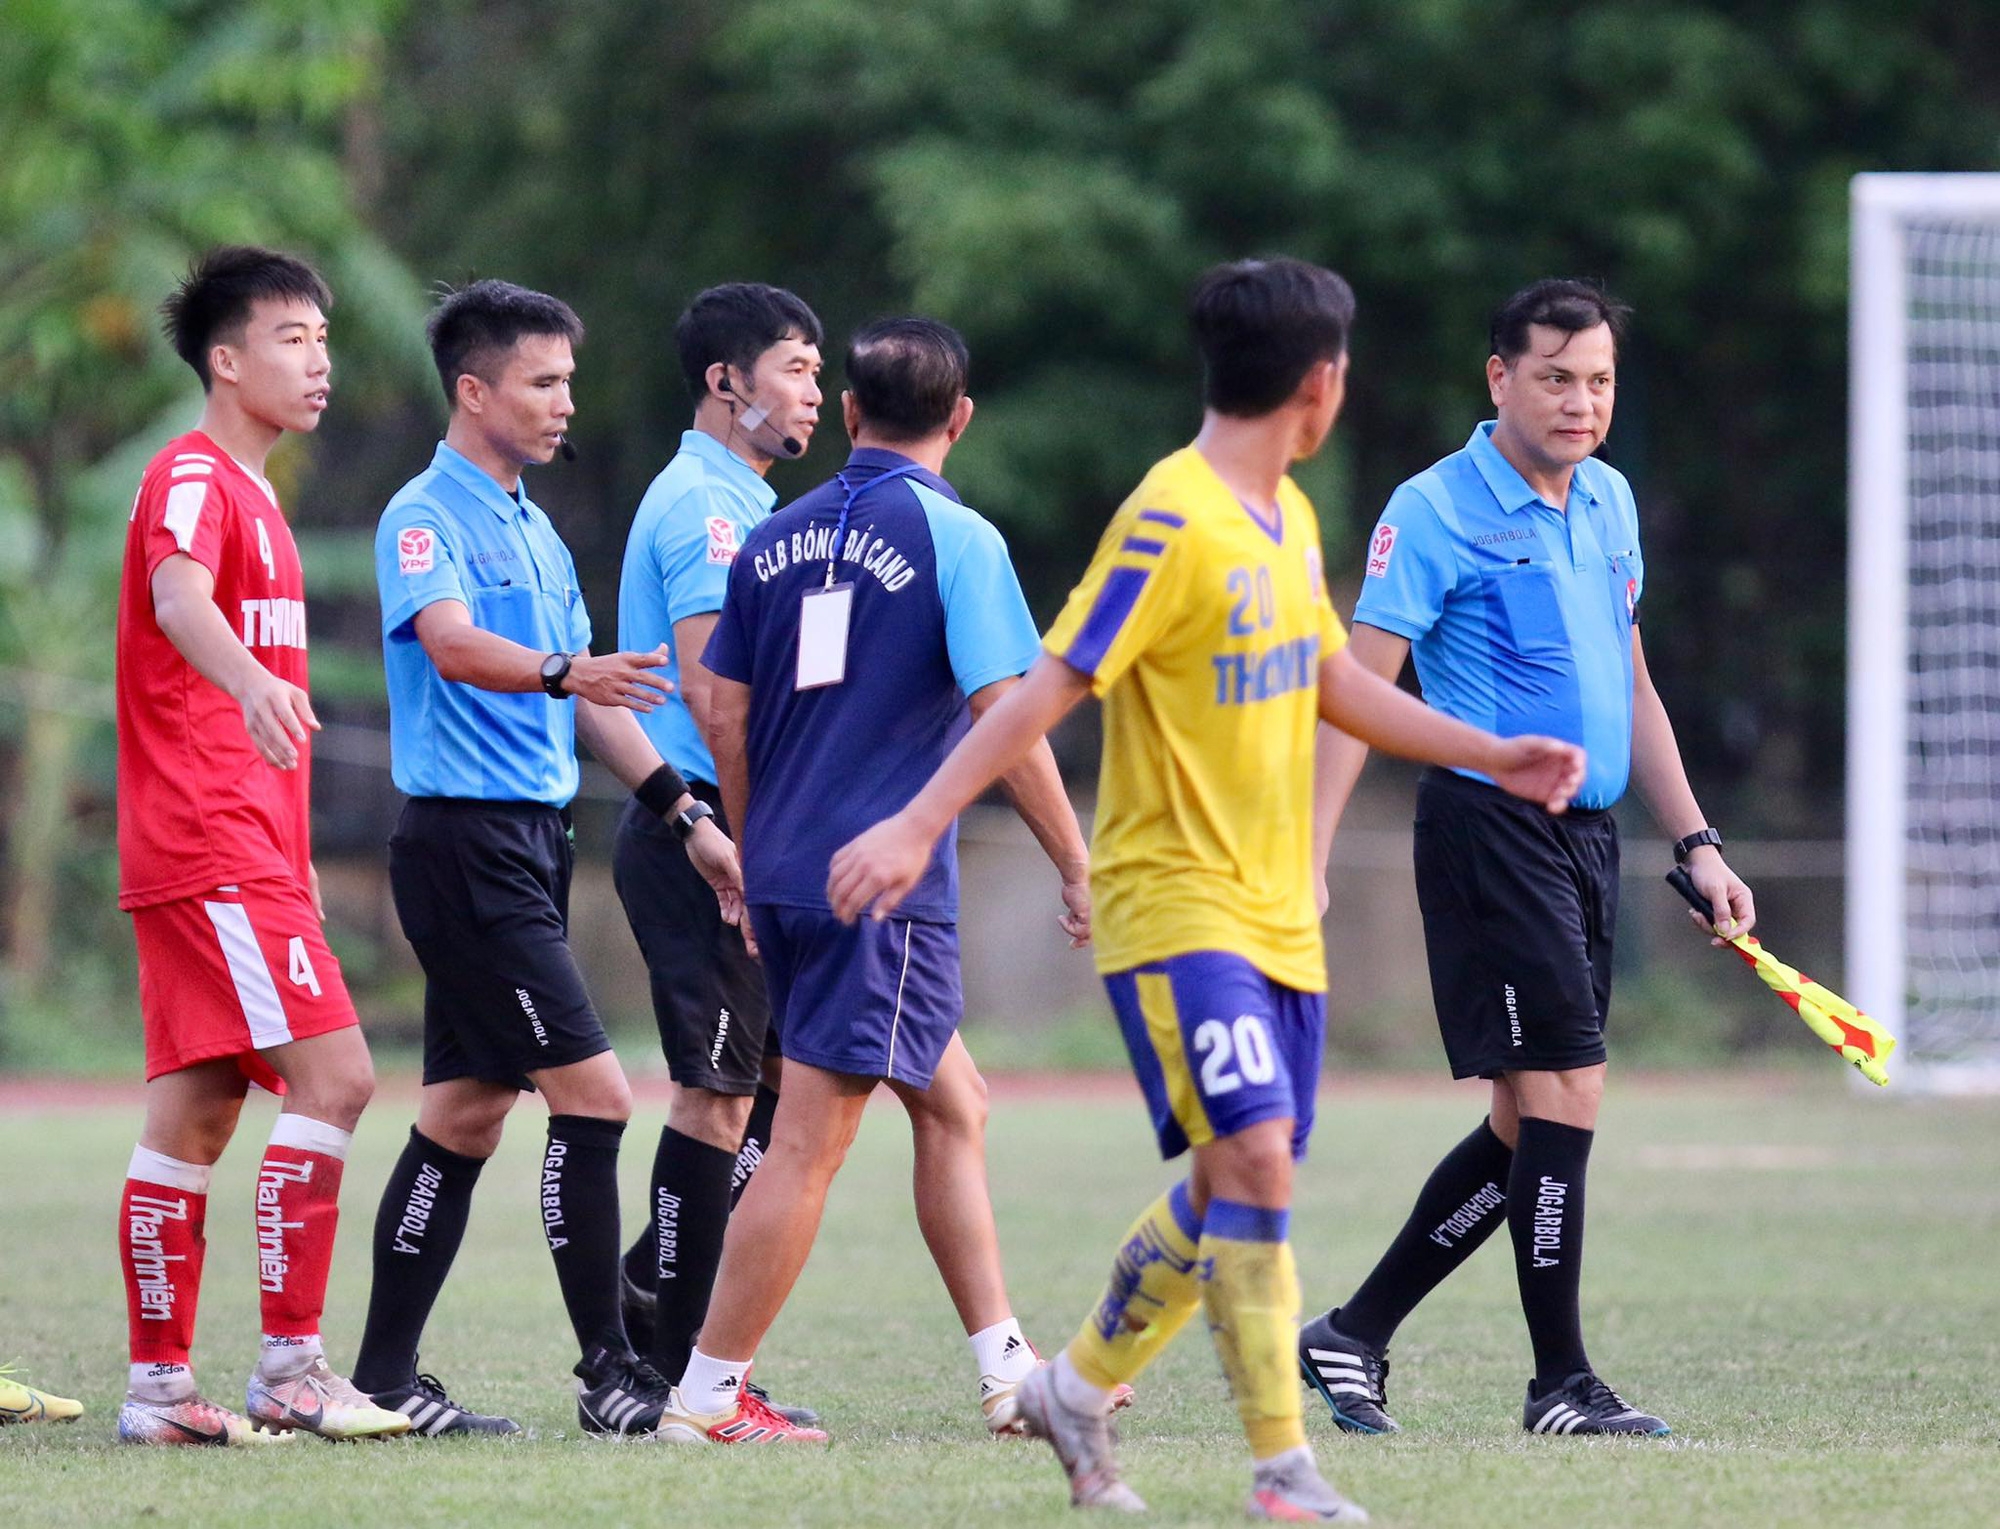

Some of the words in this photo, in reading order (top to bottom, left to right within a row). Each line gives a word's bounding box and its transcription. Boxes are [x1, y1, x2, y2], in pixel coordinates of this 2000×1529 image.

[254, 517, 276, 581] 4
[401, 559, 430, 570] VPF
[754, 539, 787, 583] CLB
[842, 523, 875, 564] ĐÁ
[862, 537, 915, 593] CAND
[1369, 558, 1387, 572] PF
[1472, 527, 1537, 547] JOGARBOLA
[1227, 565, 1274, 637] 20
[288, 934, 323, 997] 4
[515, 987, 549, 1047] JOGARBOLA
[711, 1007, 730, 1070] JOGARBOLA
[1504, 983, 1523, 1047] JOGARBOLA
[1194, 1014, 1277, 1097] 20
[392, 1162, 443, 1255] OGARBOLA
[657, 1186, 682, 1280] JOGARBOLA
[1429, 1181, 1507, 1248] JOGARBOLA
[1532, 1175, 1569, 1268] JOGARBOLA
[147, 1365, 185, 1377] adidas
